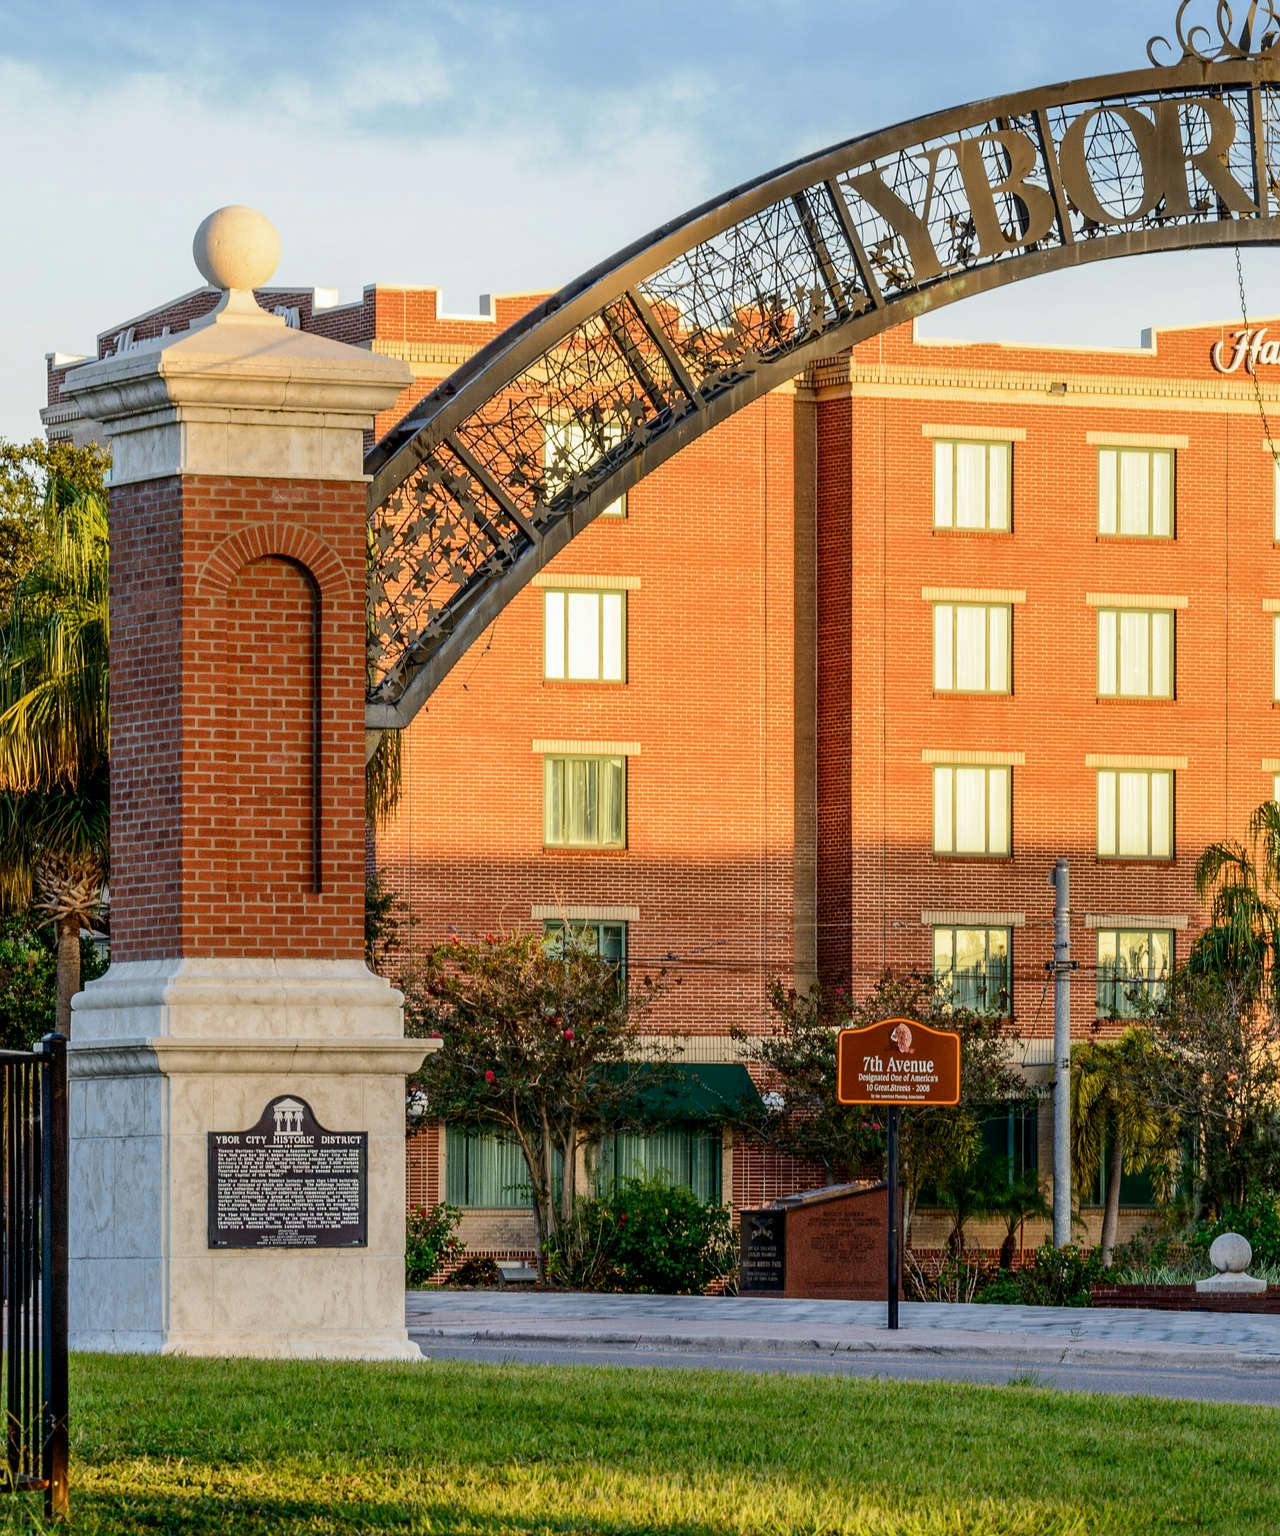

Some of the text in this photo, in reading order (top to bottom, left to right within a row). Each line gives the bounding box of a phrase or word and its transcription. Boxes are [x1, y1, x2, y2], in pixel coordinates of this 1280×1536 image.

[841, 98, 1259, 287] YBOR
[863, 1055, 935, 1073] 7th Avenue
[858, 1073, 890, 1082] Designated
[911, 1074, 939, 1082] America's
[890, 1084, 911, 1092] Streets
[916, 1084, 930, 1092] 2008
[216, 1135, 362, 1144] YBOR CITY HISTORIC DISTRICT
